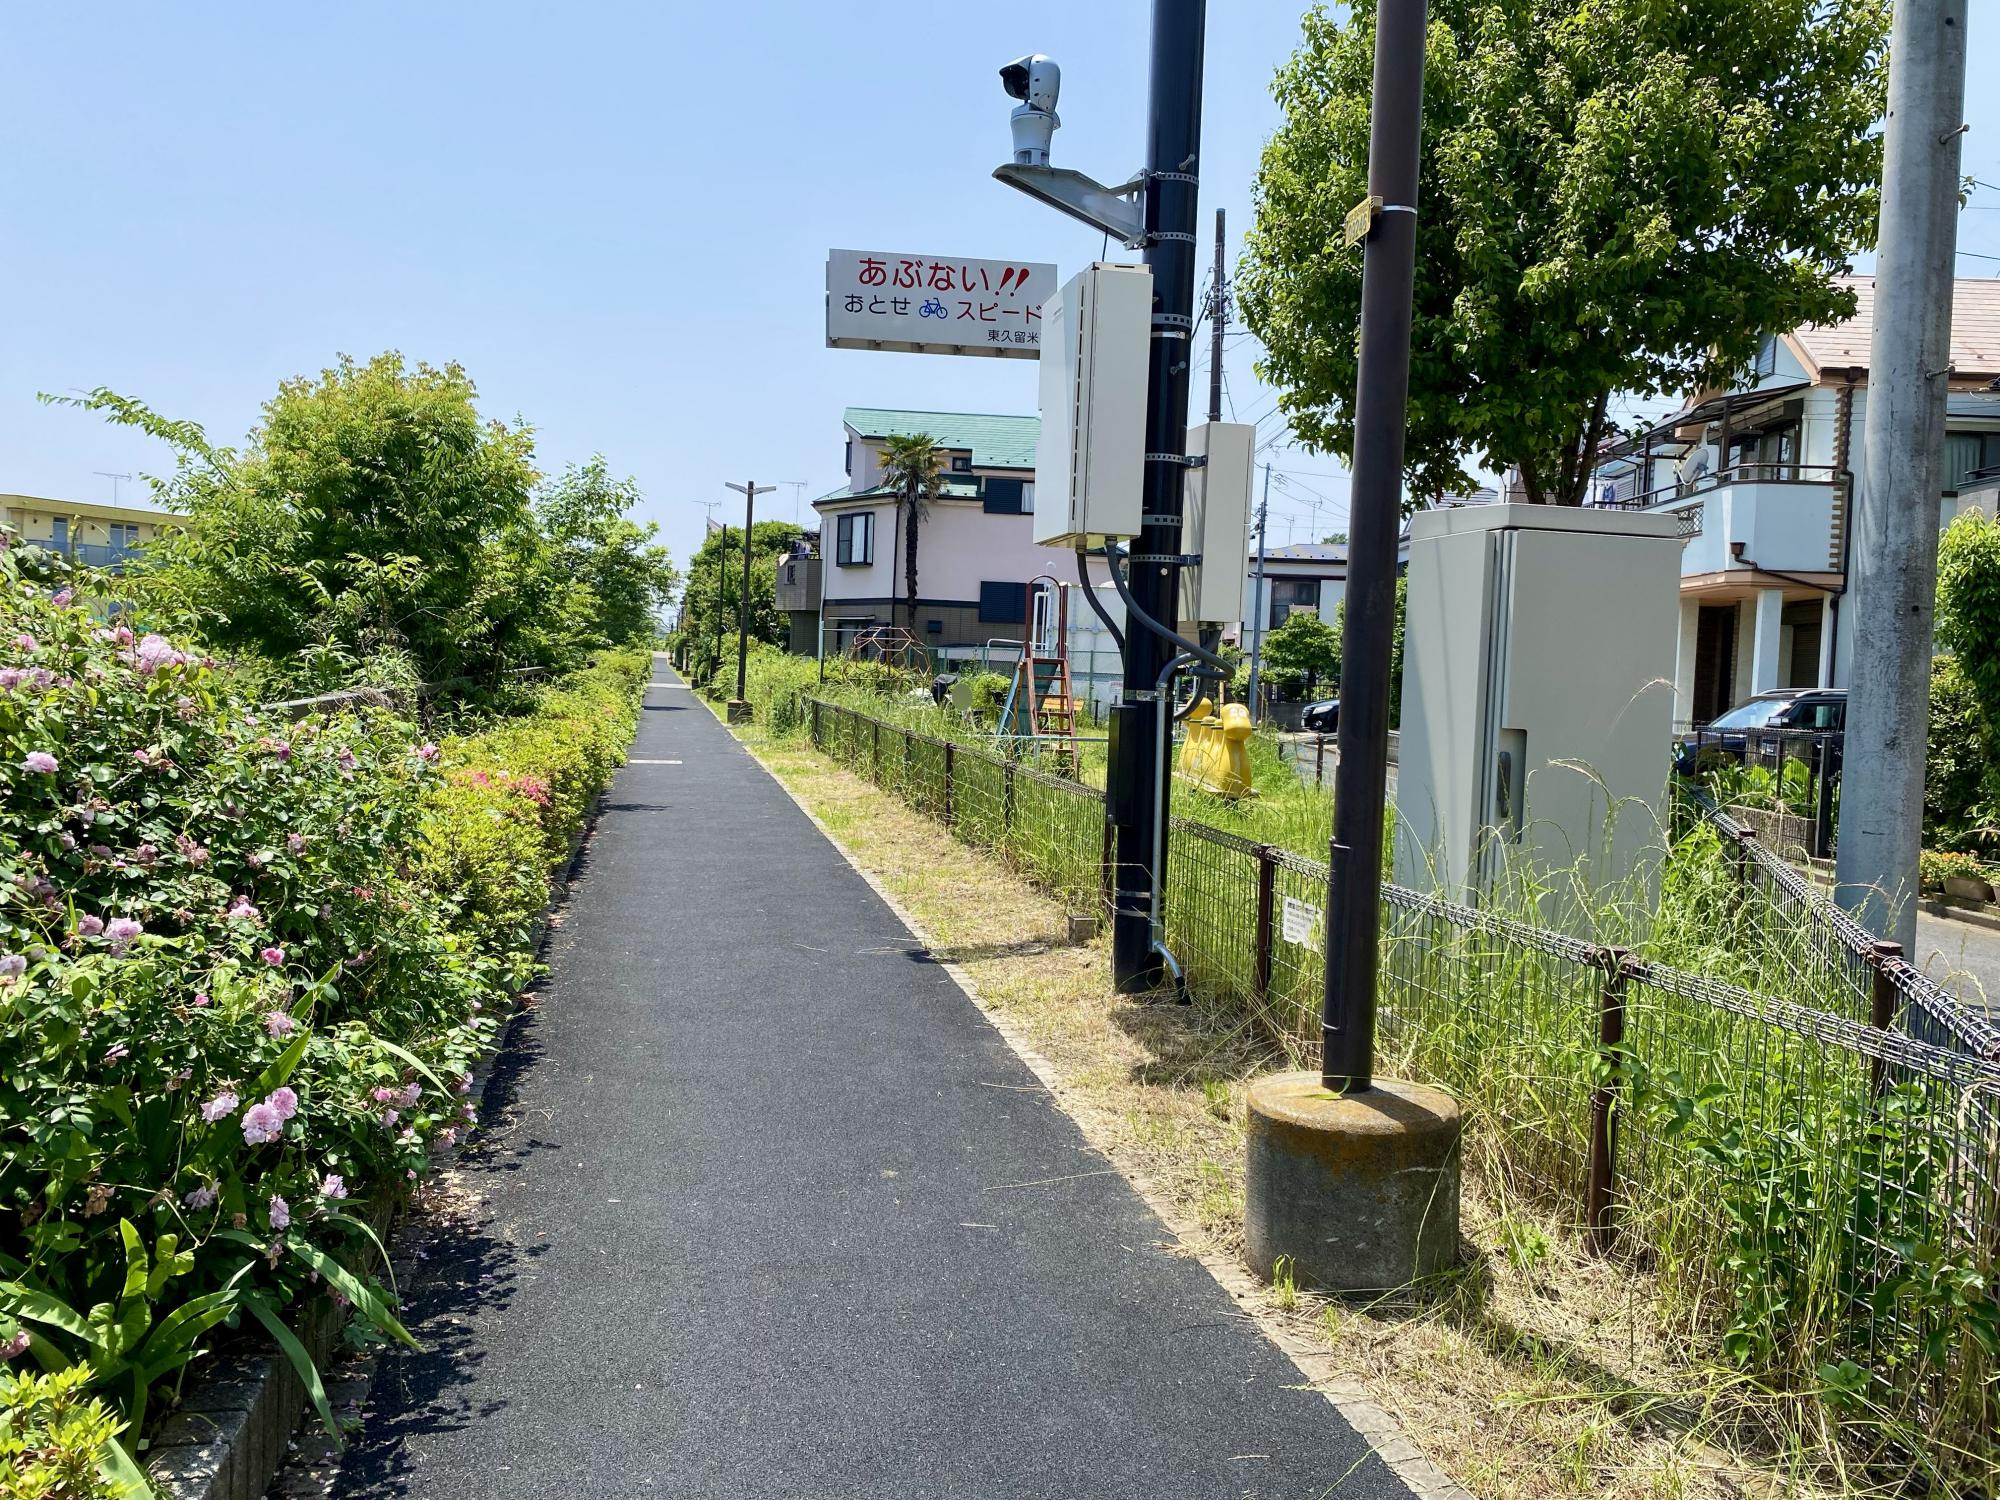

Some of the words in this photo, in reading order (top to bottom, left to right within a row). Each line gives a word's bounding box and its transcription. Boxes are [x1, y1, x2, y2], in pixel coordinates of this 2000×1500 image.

[845, 294, 911, 316] おとせ
[957, 301, 1042, 324] スピード
